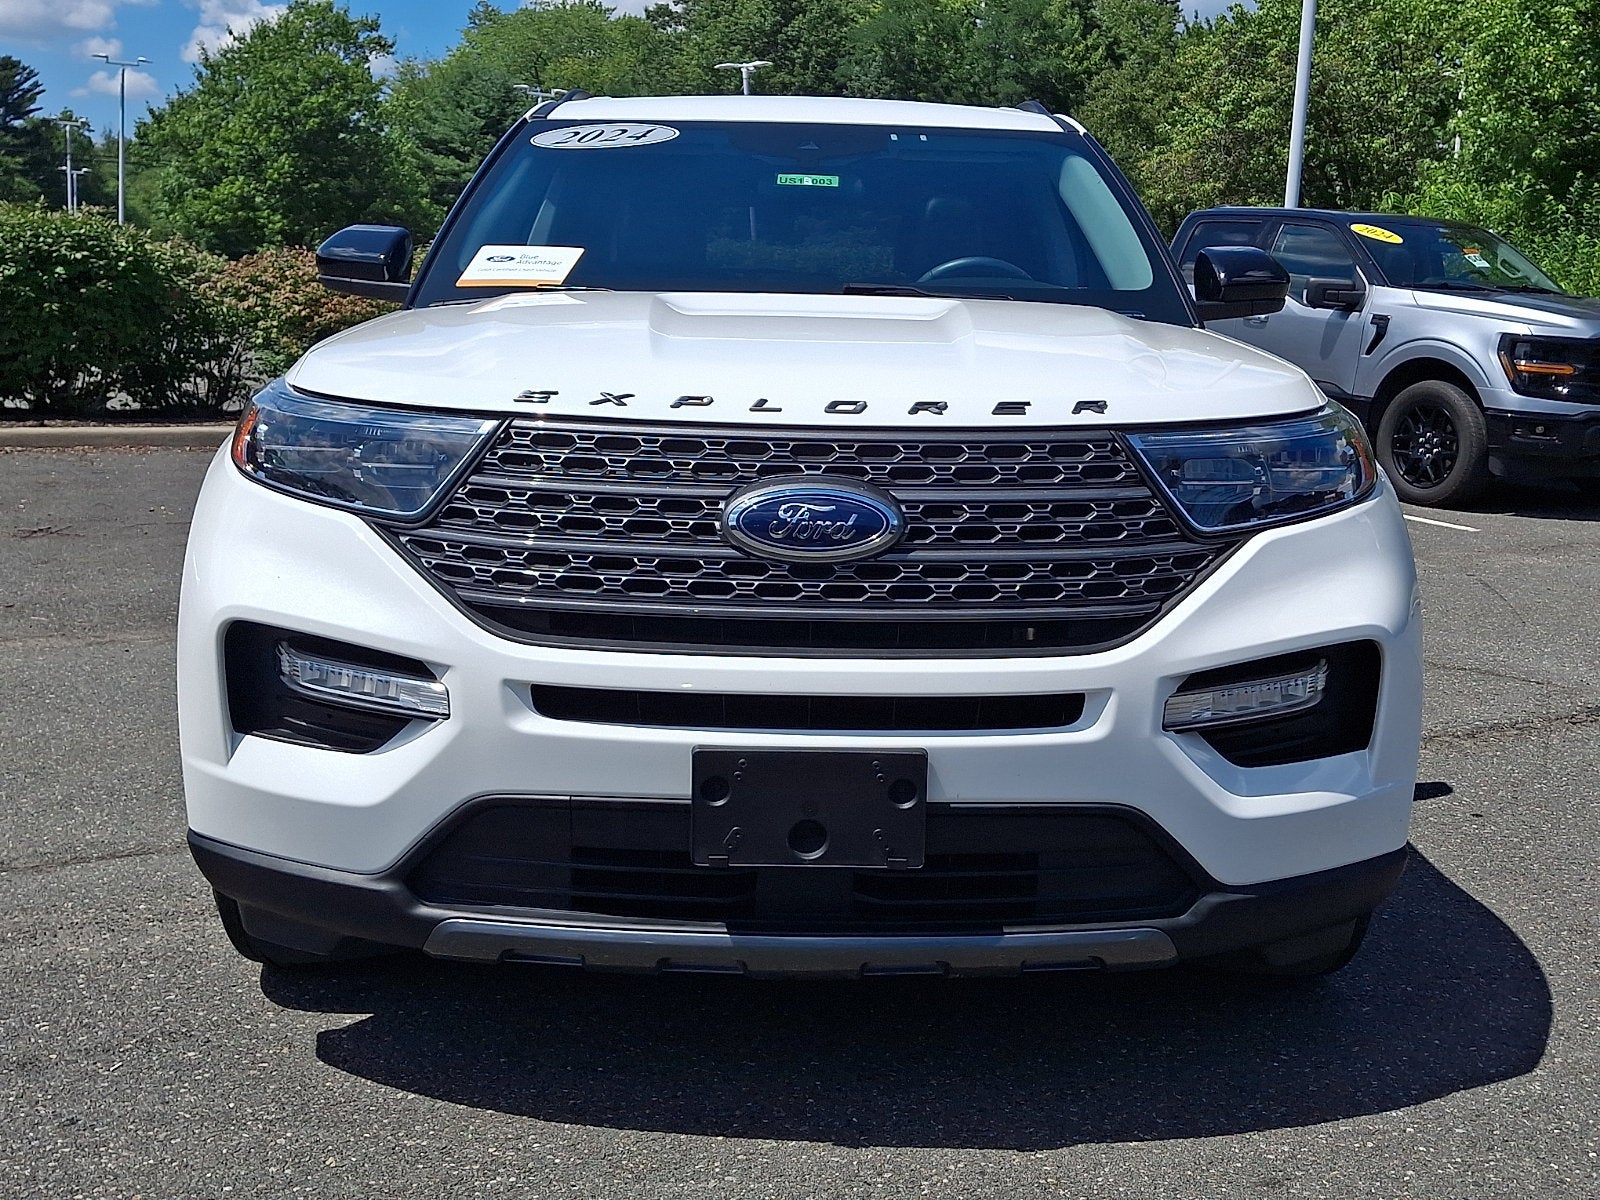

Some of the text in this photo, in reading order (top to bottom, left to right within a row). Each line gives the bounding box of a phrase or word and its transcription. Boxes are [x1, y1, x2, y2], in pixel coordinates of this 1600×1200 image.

[551, 127, 657, 145] 2024
[1358, 226, 1395, 239] 2024
[512, 389, 1109, 416] EXPLORER
[768, 502, 857, 540] Ford
